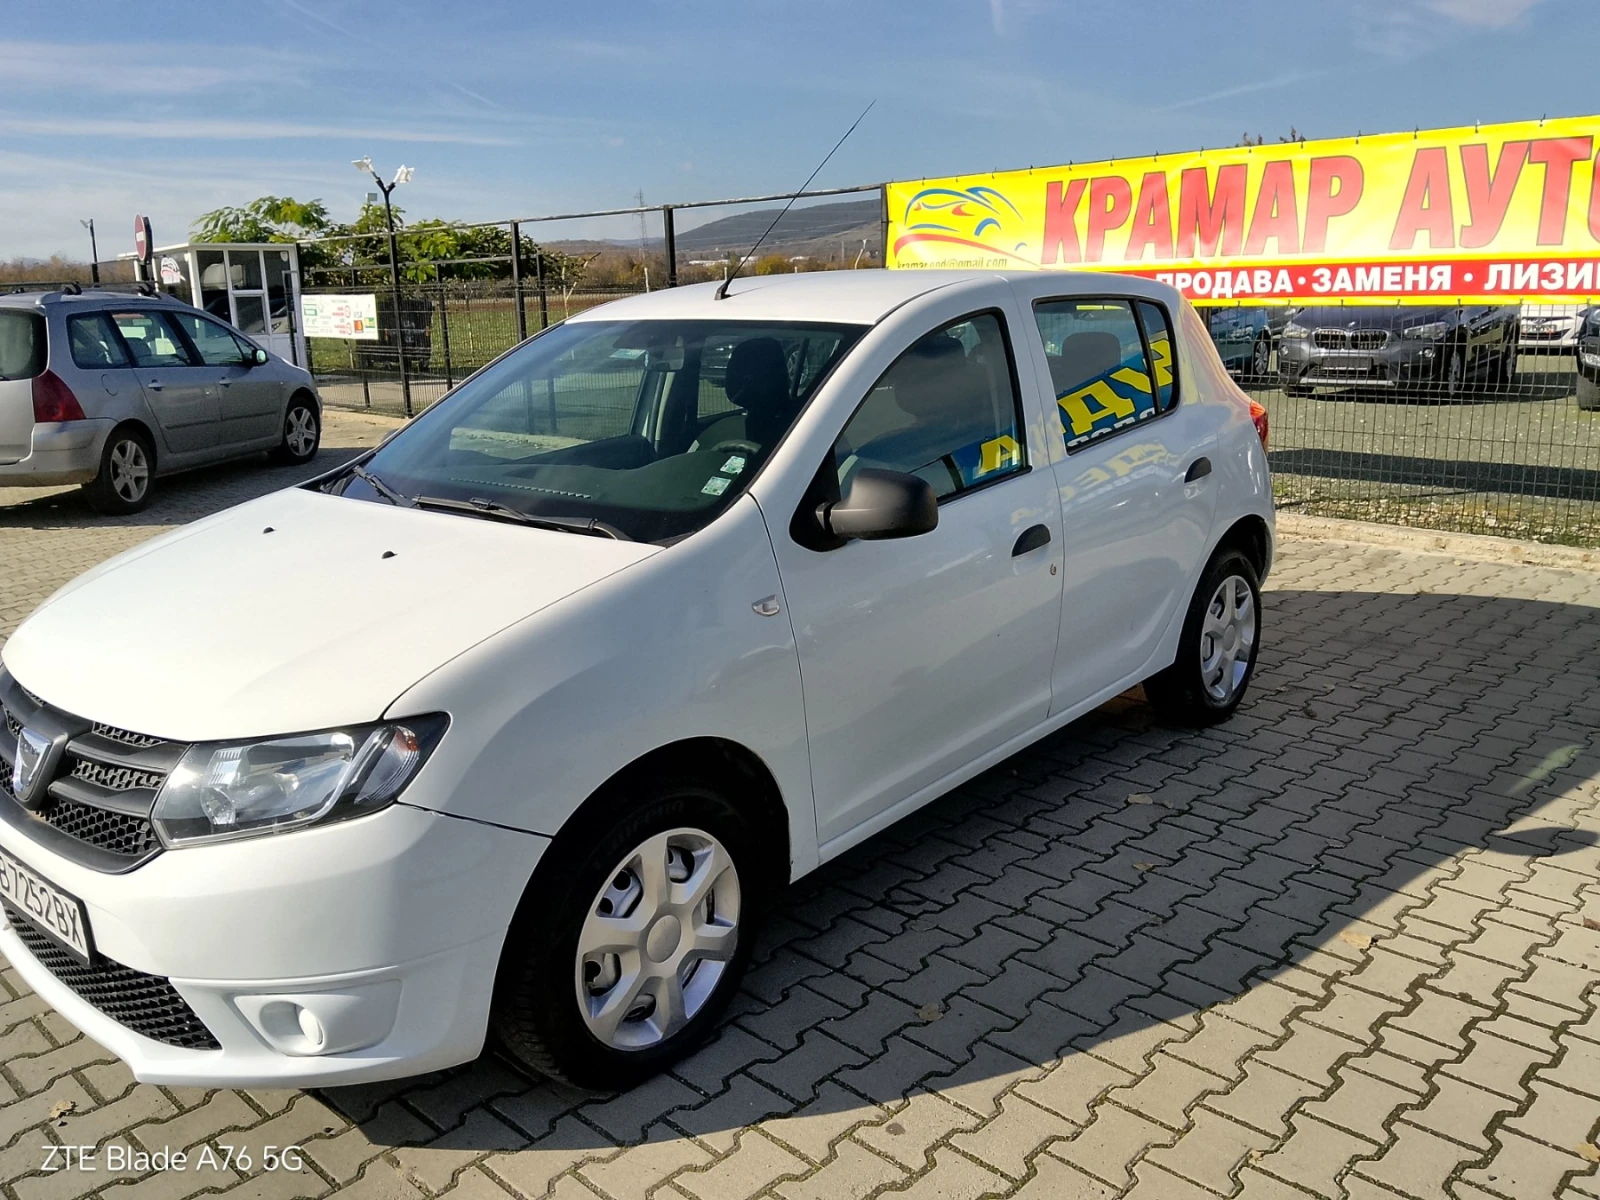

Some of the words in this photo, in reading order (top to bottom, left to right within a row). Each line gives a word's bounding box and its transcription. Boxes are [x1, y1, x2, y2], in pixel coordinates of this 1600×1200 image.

[1041, 155, 1365, 265] КРАМАР
[1388, 135, 1600, 250] АУТ
[1311, 264, 1452, 293] ЗАМЕНЯ
[1484, 262, 1600, 291] ЛИЗИ
